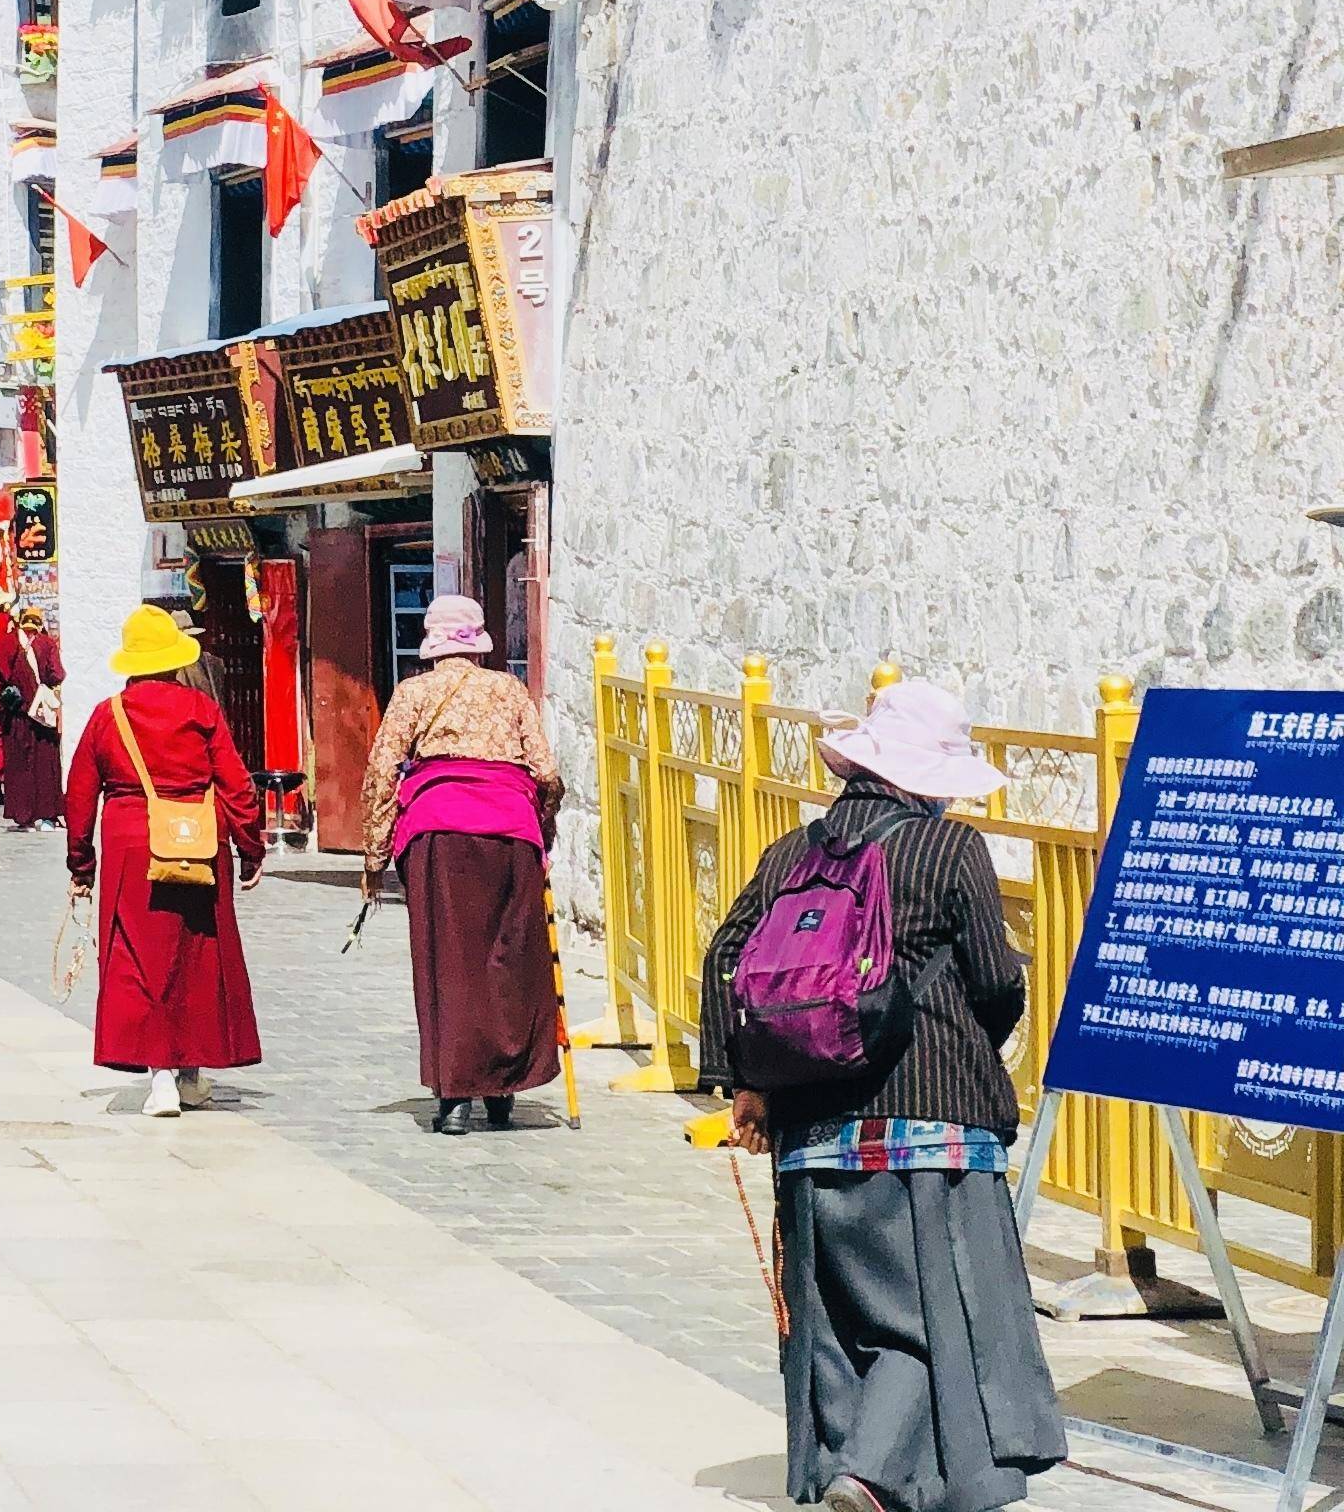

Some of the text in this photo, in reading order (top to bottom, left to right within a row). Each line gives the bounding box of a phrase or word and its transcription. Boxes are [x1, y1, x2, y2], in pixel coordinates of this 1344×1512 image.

[142, 420, 242, 468] 格桑梅朵
[1247, 710, 1344, 741] 施工安民告示
